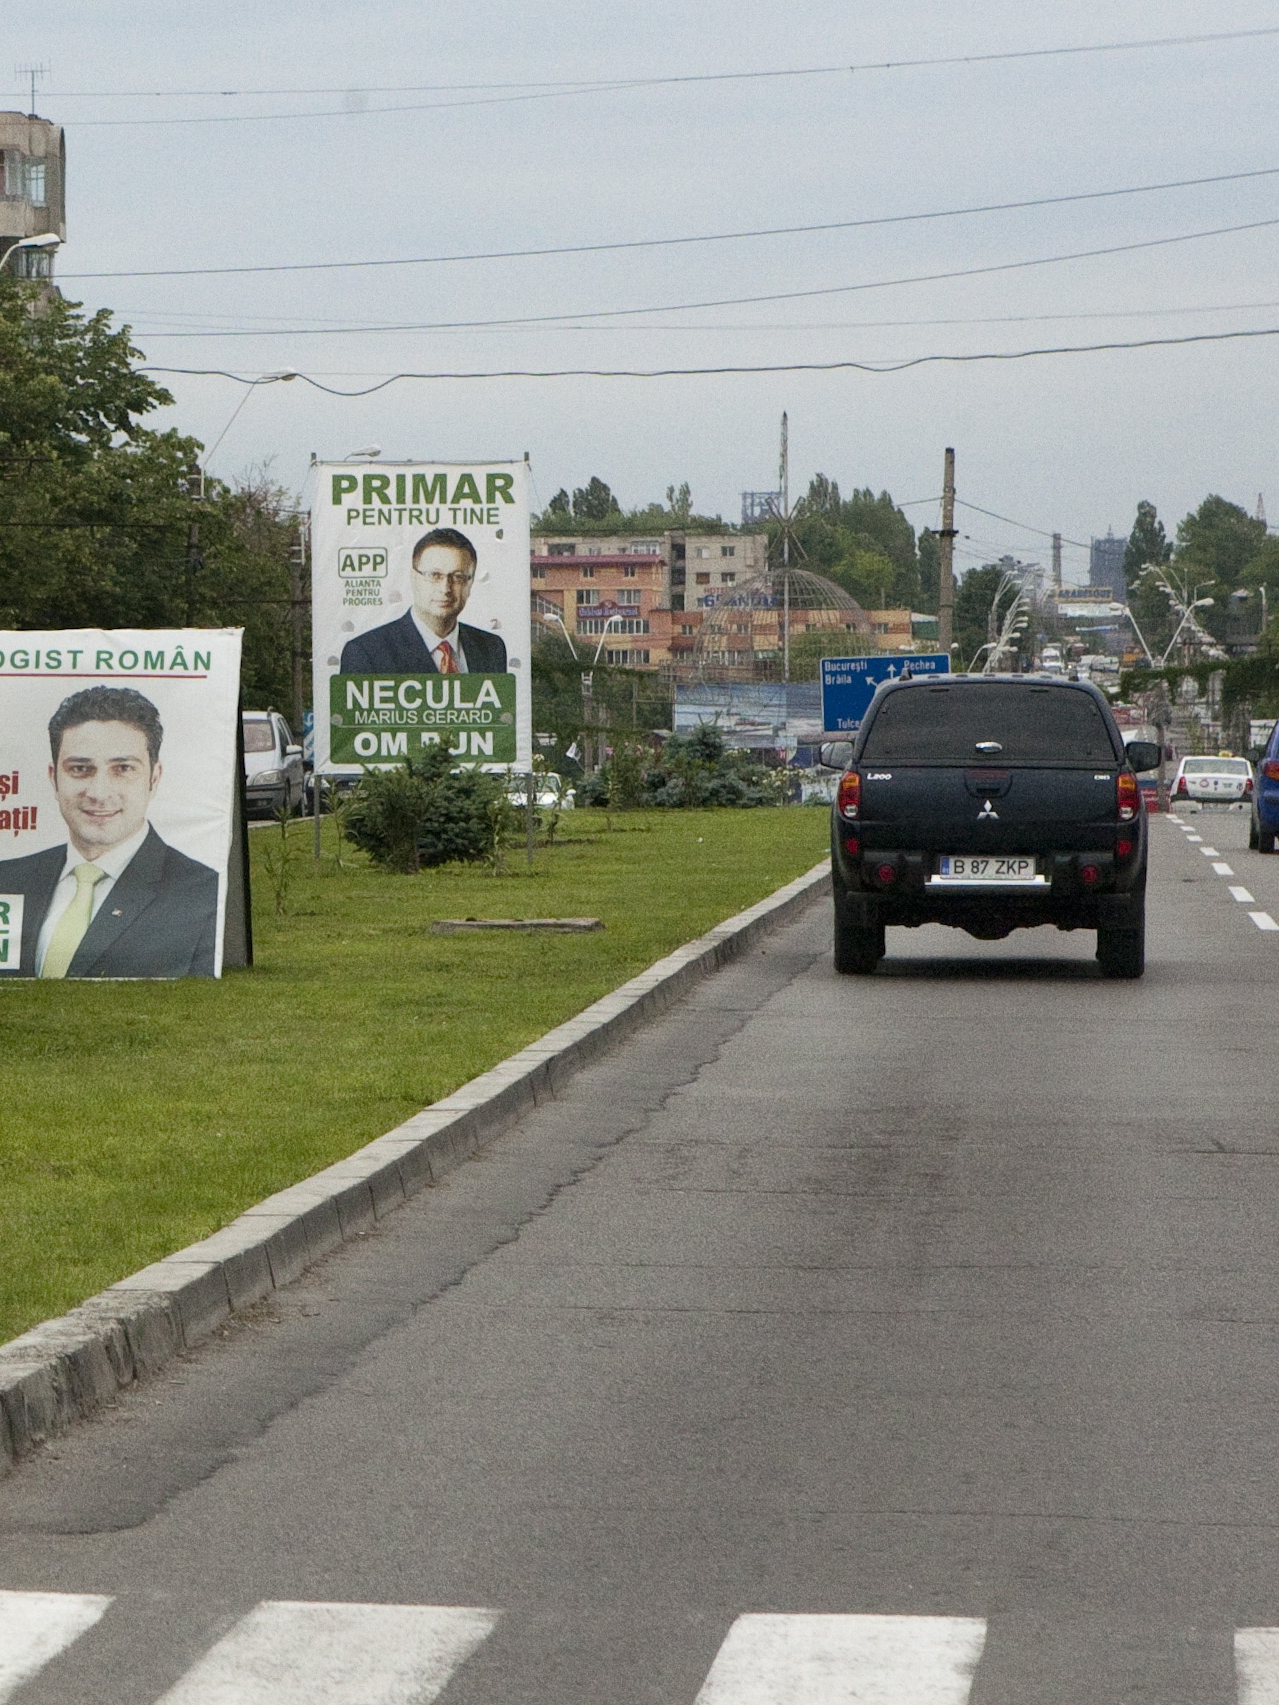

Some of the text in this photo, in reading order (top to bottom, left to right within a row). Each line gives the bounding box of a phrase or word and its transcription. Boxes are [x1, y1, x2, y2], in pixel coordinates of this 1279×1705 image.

[331, 473, 515, 506] PRIMAR
[346, 507, 500, 526] PENTRU TINE
[341, 554, 385, 572] APP
[342, 597, 383, 606] PROGRES
[345, 589, 380, 597] PENTRU
[95, 645, 211, 671] ROMÂN
[346, 679, 501, 710] NECULA
[355, 710, 493, 724] MARIUS GERARD
[837, 718, 861, 729] Tulce
[353, 731, 408, 757] OM
[953, 859, 1029, 875] B 87 ZKP
